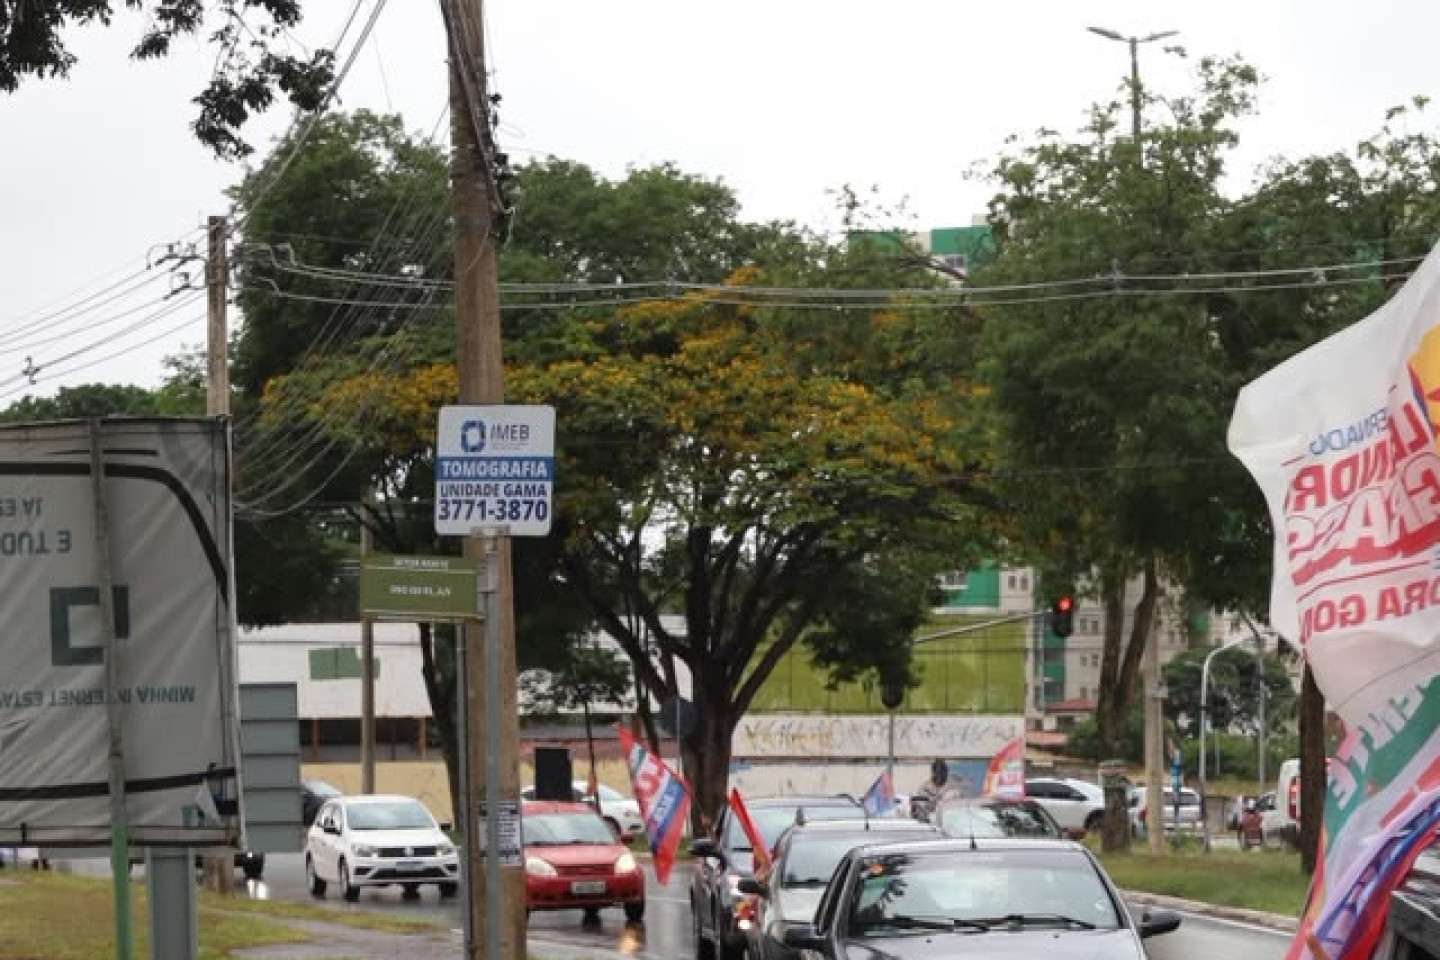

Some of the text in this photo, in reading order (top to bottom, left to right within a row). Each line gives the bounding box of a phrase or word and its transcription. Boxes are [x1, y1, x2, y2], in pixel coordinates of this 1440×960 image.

[489, 424, 530, 441] IMEB
[441, 459, 549, 478] TOMOGRAFIA
[440, 483, 547, 497] UNIDADE GAMA
[438, 499, 548, 520] 3771-3870
